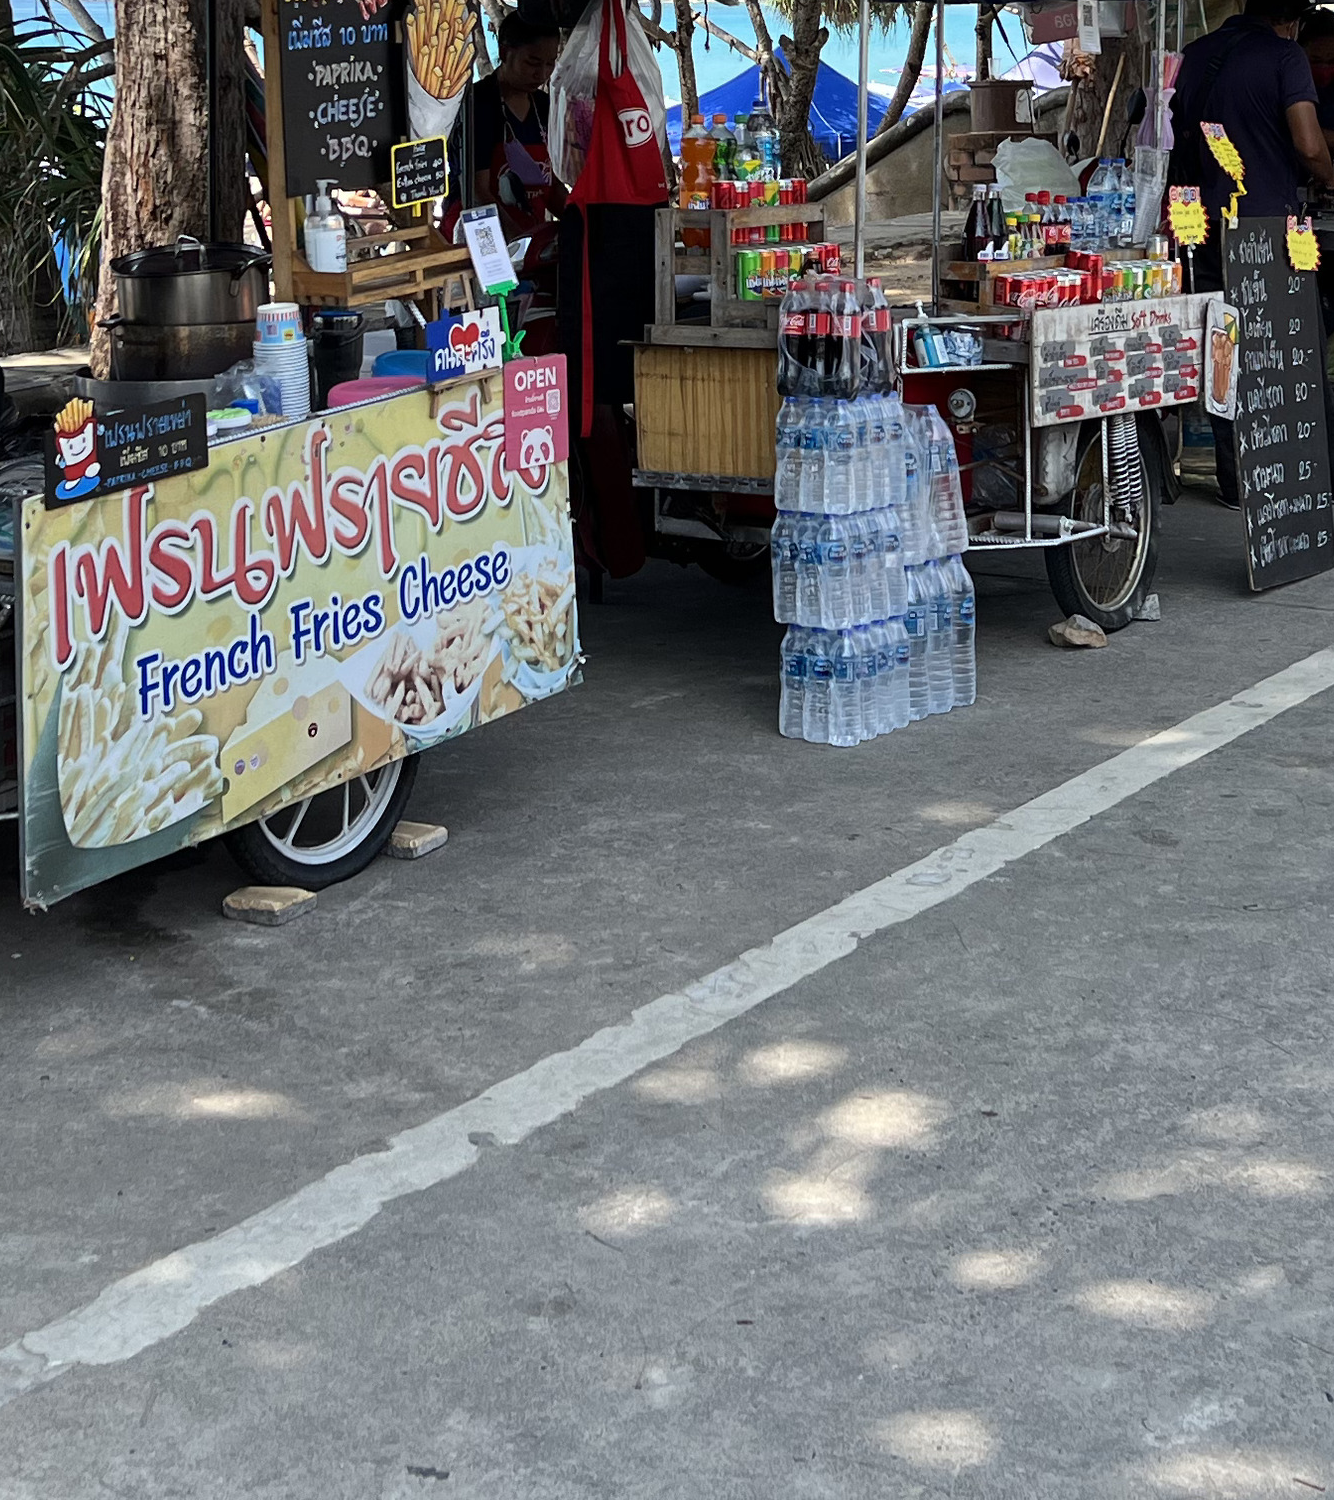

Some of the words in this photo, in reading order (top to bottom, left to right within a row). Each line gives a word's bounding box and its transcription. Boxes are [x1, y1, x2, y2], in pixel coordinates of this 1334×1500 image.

[339, 26, 356, 46] 10
[360, 22, 388, 44] บาท
[315, 59, 376, 88] PAPRIKA
[316, 90, 377, 128] CHEESE
[327, 135, 371, 162] BBQ
[1131, 310, 1147, 329] Soft
[1149, 309, 1172, 327] Drinks
[435, 320, 495, 372] คนละครึ่ง
[514, 366, 558, 392] OPEN
[136, 615, 271, 715] French
[291, 594, 383, 655] Fries
[400, 549, 511, 620] Cheese
